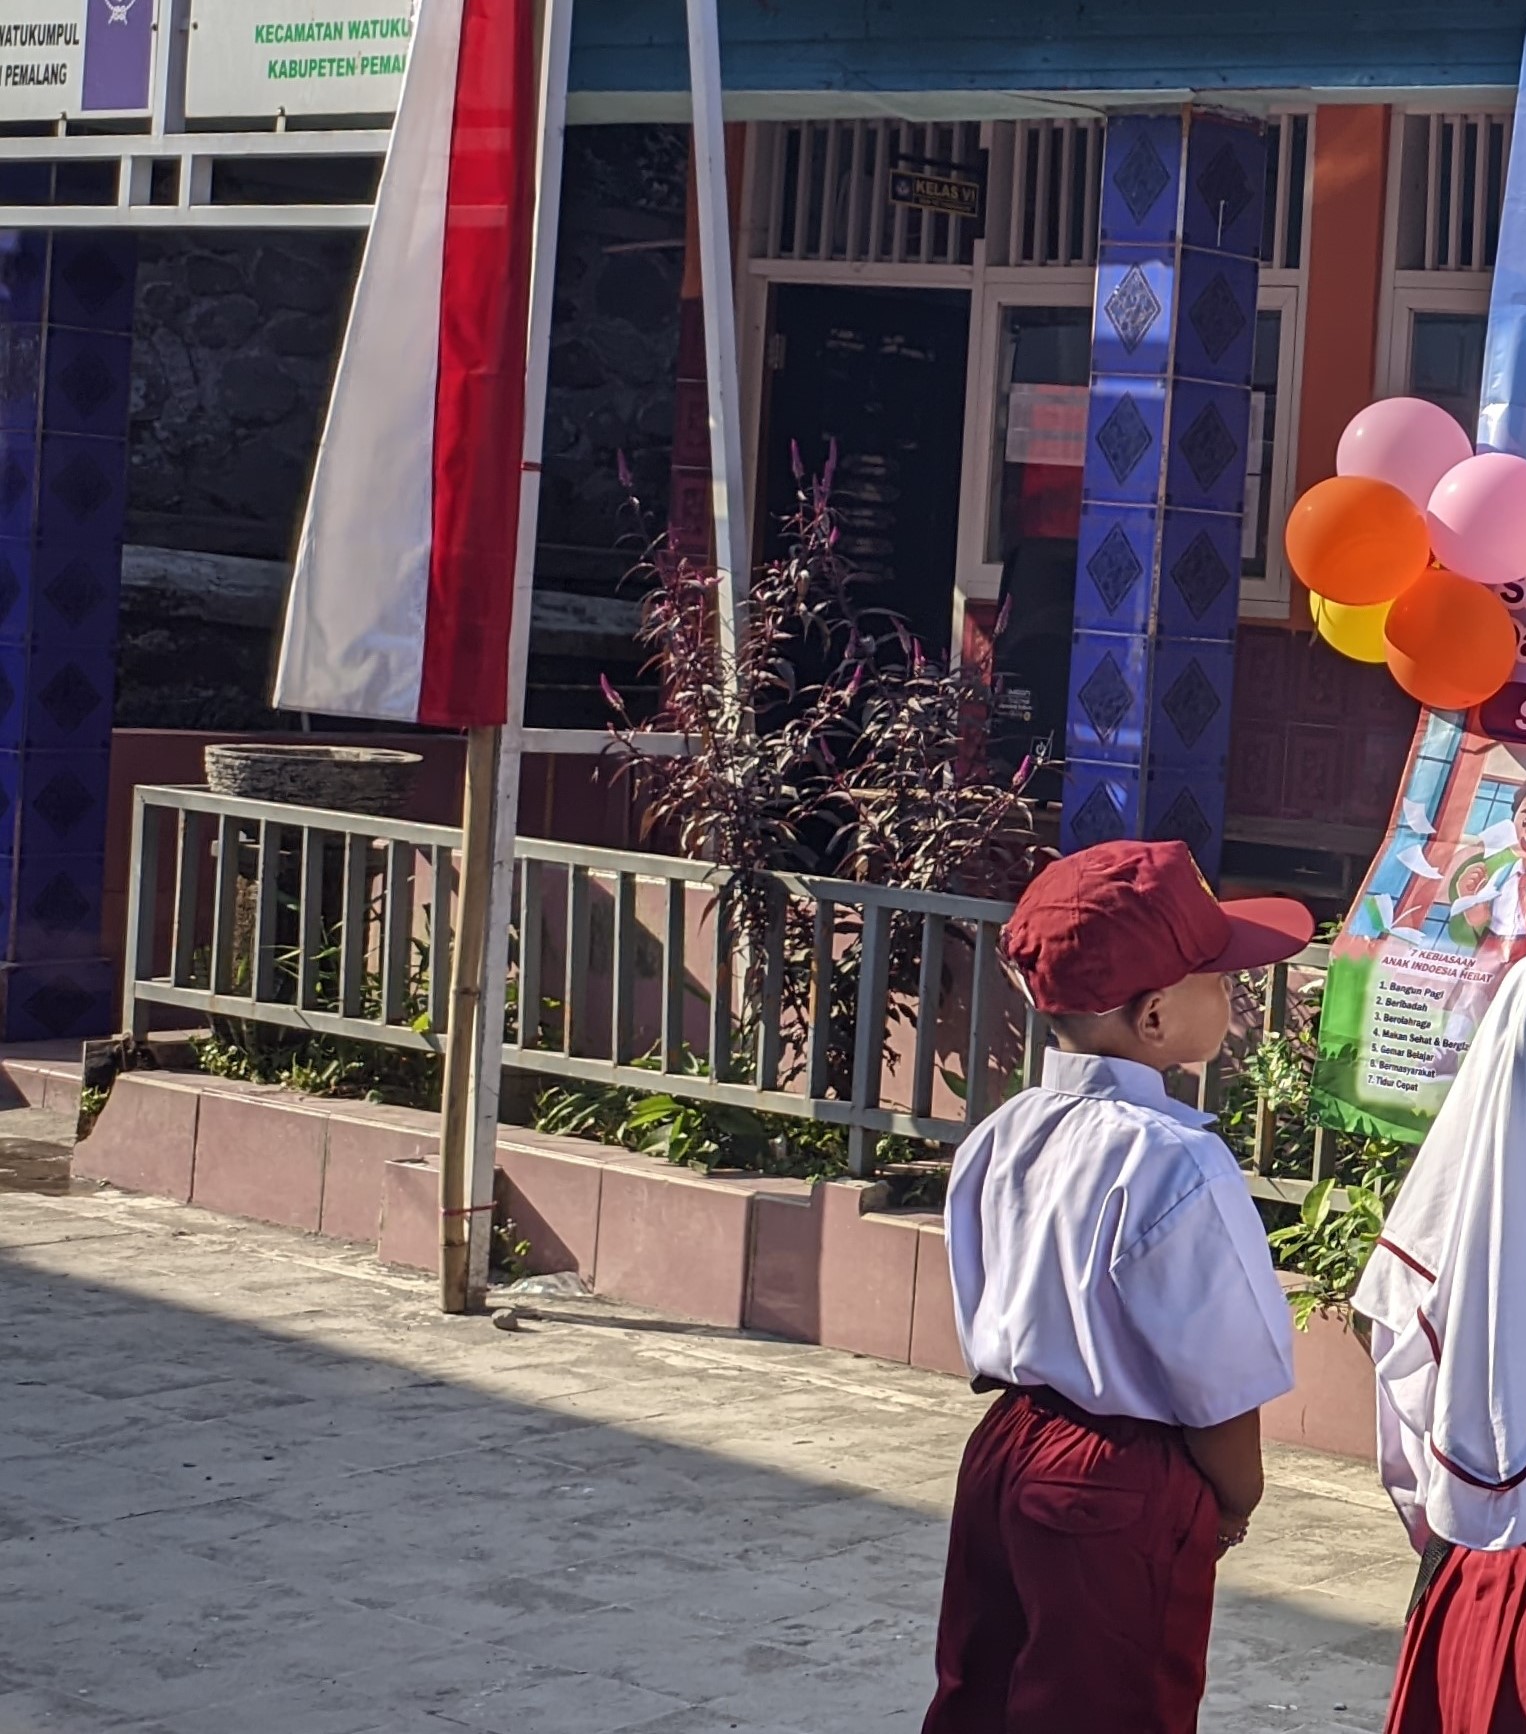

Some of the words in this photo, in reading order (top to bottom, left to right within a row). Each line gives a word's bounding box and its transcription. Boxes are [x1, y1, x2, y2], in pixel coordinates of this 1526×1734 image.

[255, 21, 344, 43] KECAMATAN
[5, 63, 67, 86] PEMALANG
[268, 57, 356, 79] KABUPETEN
[916, 179, 959, 198] KELAS
[1410, 949, 1417, 957] 7
[1419, 950, 1476, 967] KEBIASAAN
[1382, 957, 1409, 969] ANAK
[1411, 962, 1457, 977] INDOESIA
[1460, 969, 1493, 983] HEBAT
[1379, 981, 1387, 990] 1.
[1390, 982, 1422, 995] Bangun
[1424, 988, 1444, 1000] Pagi
[1376, 996, 1383, 1005] 2.
[1385, 998, 1428, 1012] Beribadah
[1374, 1012, 1381, 1021] 3.
[1373, 1028, 1380, 1037] 4.
[1382, 1029, 1407, 1041] Makan
[1409, 1033, 1432, 1045] Sehat
[1434, 1037, 1440, 1046] &
[1371, 1043, 1378, 1052] 5.
[1381, 1045, 1405, 1057] Gemar
[1407, 1049, 1434, 1062] Belajar
[1379, 1061, 1436, 1078] Bermasyarakat
[1368, 1074, 1375, 1084] 7.
[1376, 1076, 1394, 1087] Tidur
